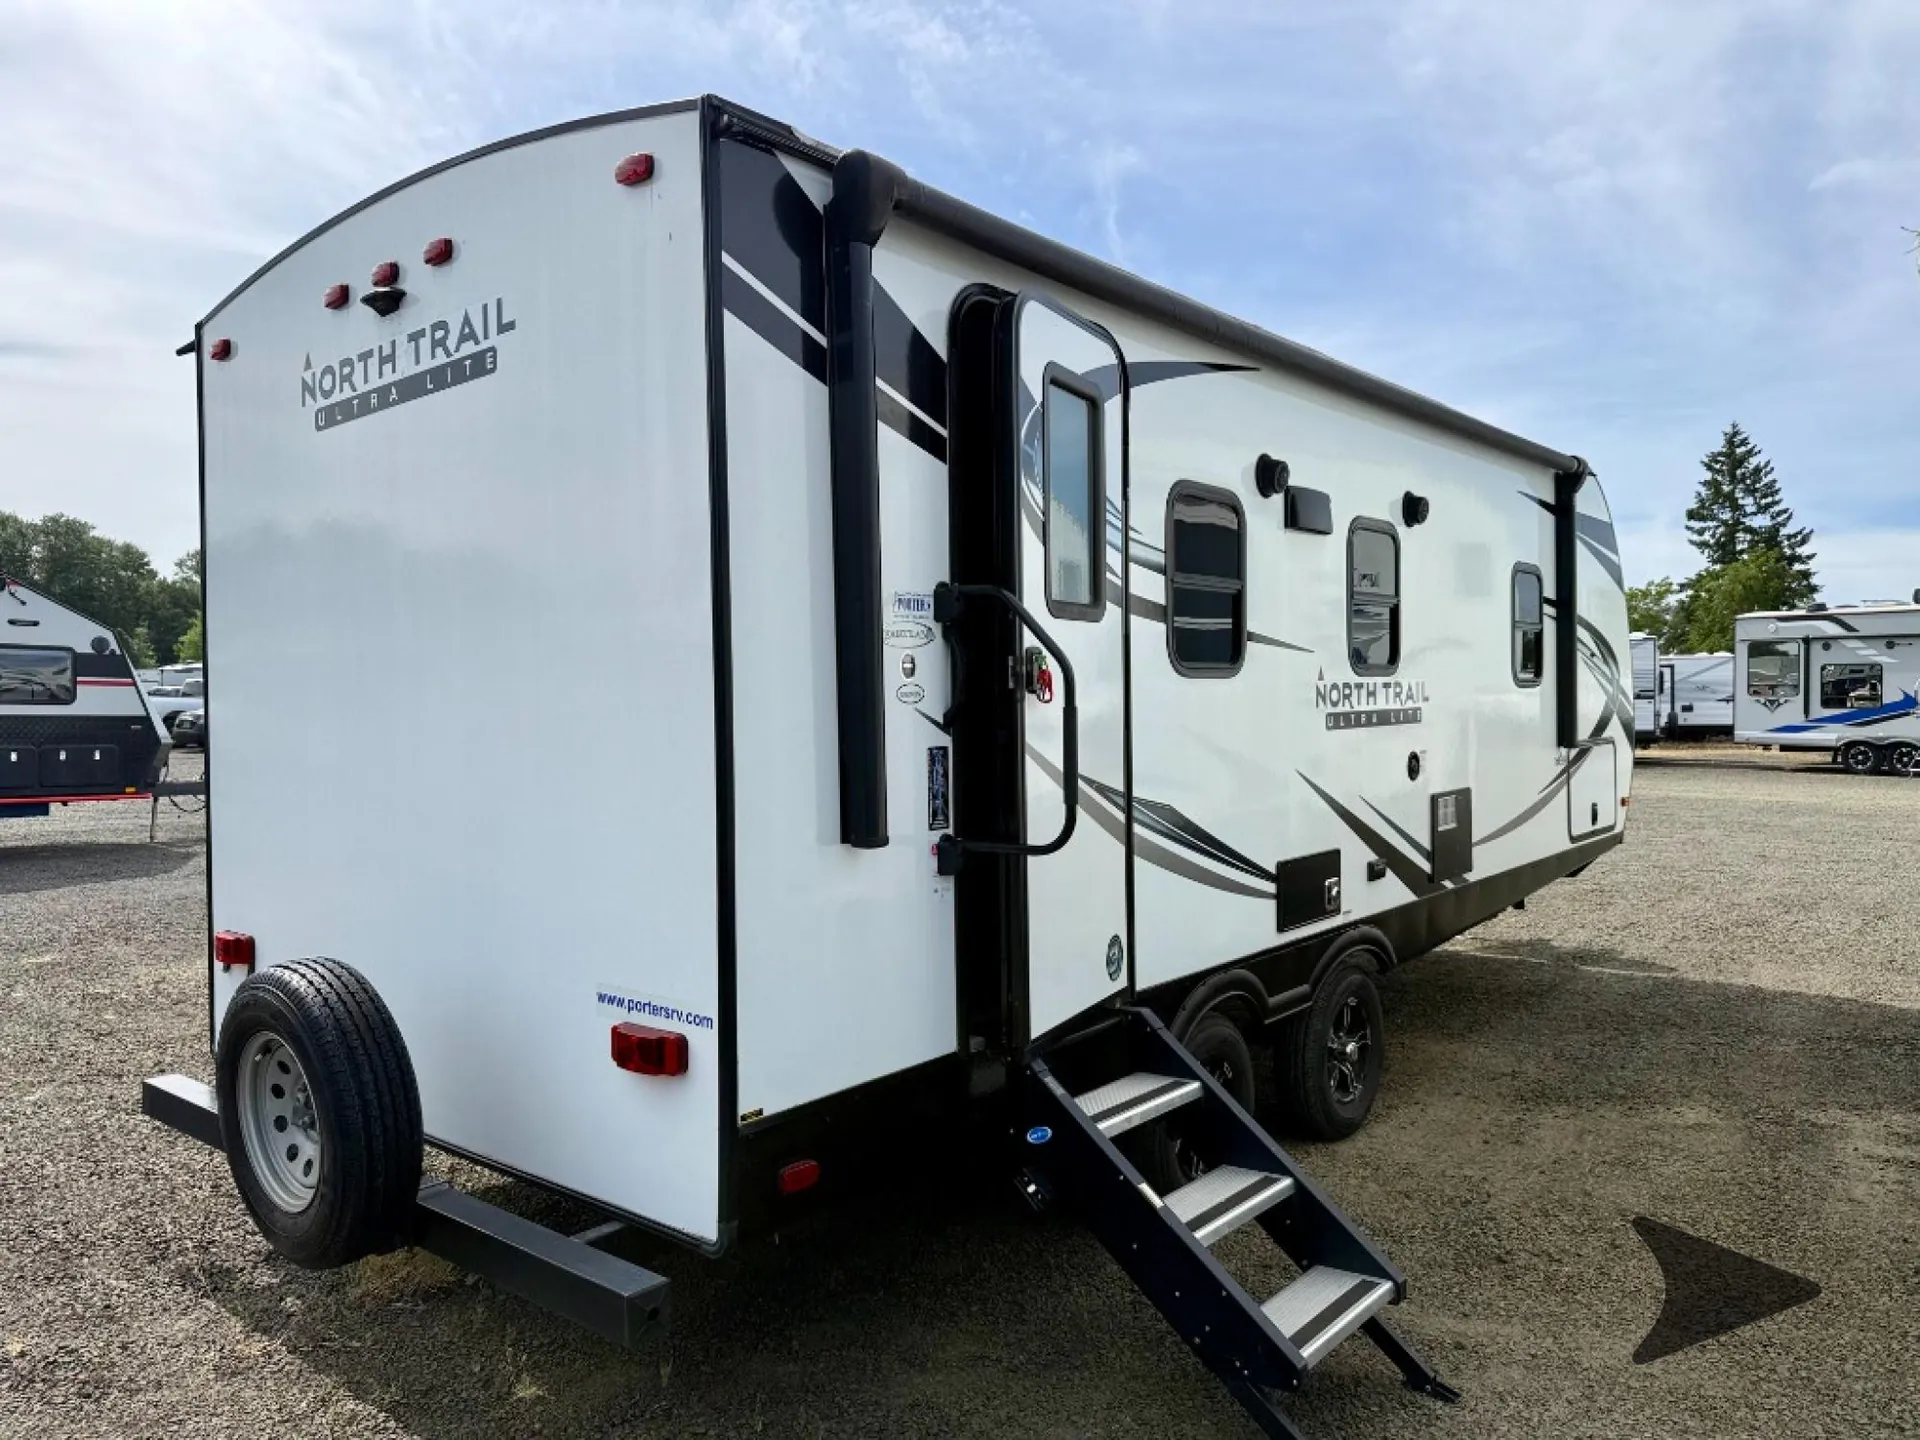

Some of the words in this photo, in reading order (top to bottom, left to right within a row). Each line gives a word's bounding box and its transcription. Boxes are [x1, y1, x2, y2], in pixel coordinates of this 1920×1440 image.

[301, 339, 397, 408] NORTH
[406, 297, 516, 367] TRAIL
[318, 386, 399, 427] ULTRA
[426, 351, 494, 389] LITE
[1315, 681, 1377, 709] NORTH
[1382, 680, 1430, 705] TRAIL
[1327, 712, 1377, 727] ULTRA
[1390, 710, 1422, 723] LITE
[596, 991, 714, 1030] www.portersrv.com
